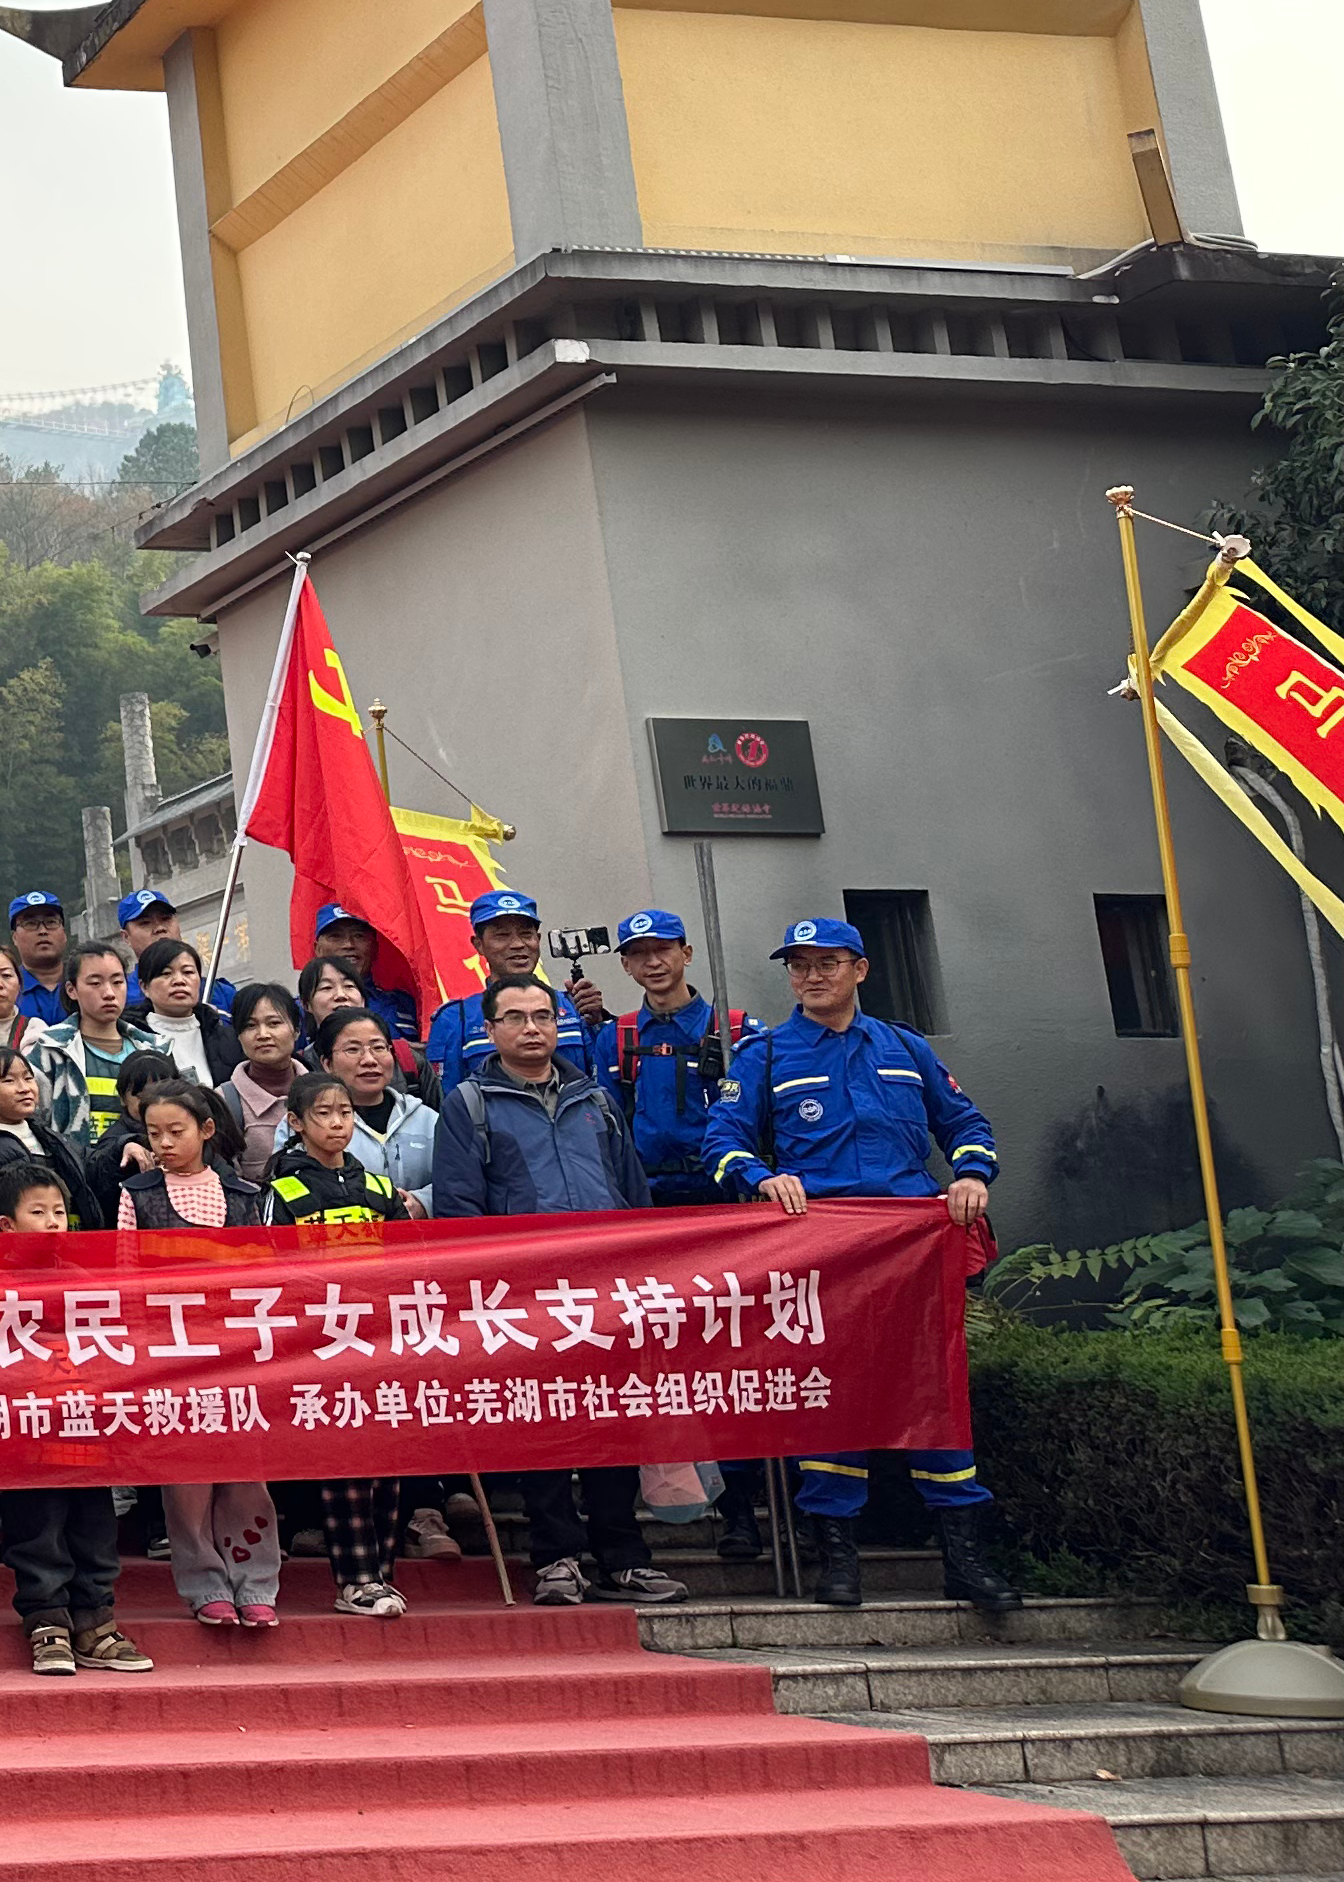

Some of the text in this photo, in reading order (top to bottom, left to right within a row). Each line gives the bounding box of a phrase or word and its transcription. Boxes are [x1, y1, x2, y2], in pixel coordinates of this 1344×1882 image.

[289, 1365, 833, 1432] 承办单位:芜湖市社会组织促进会
